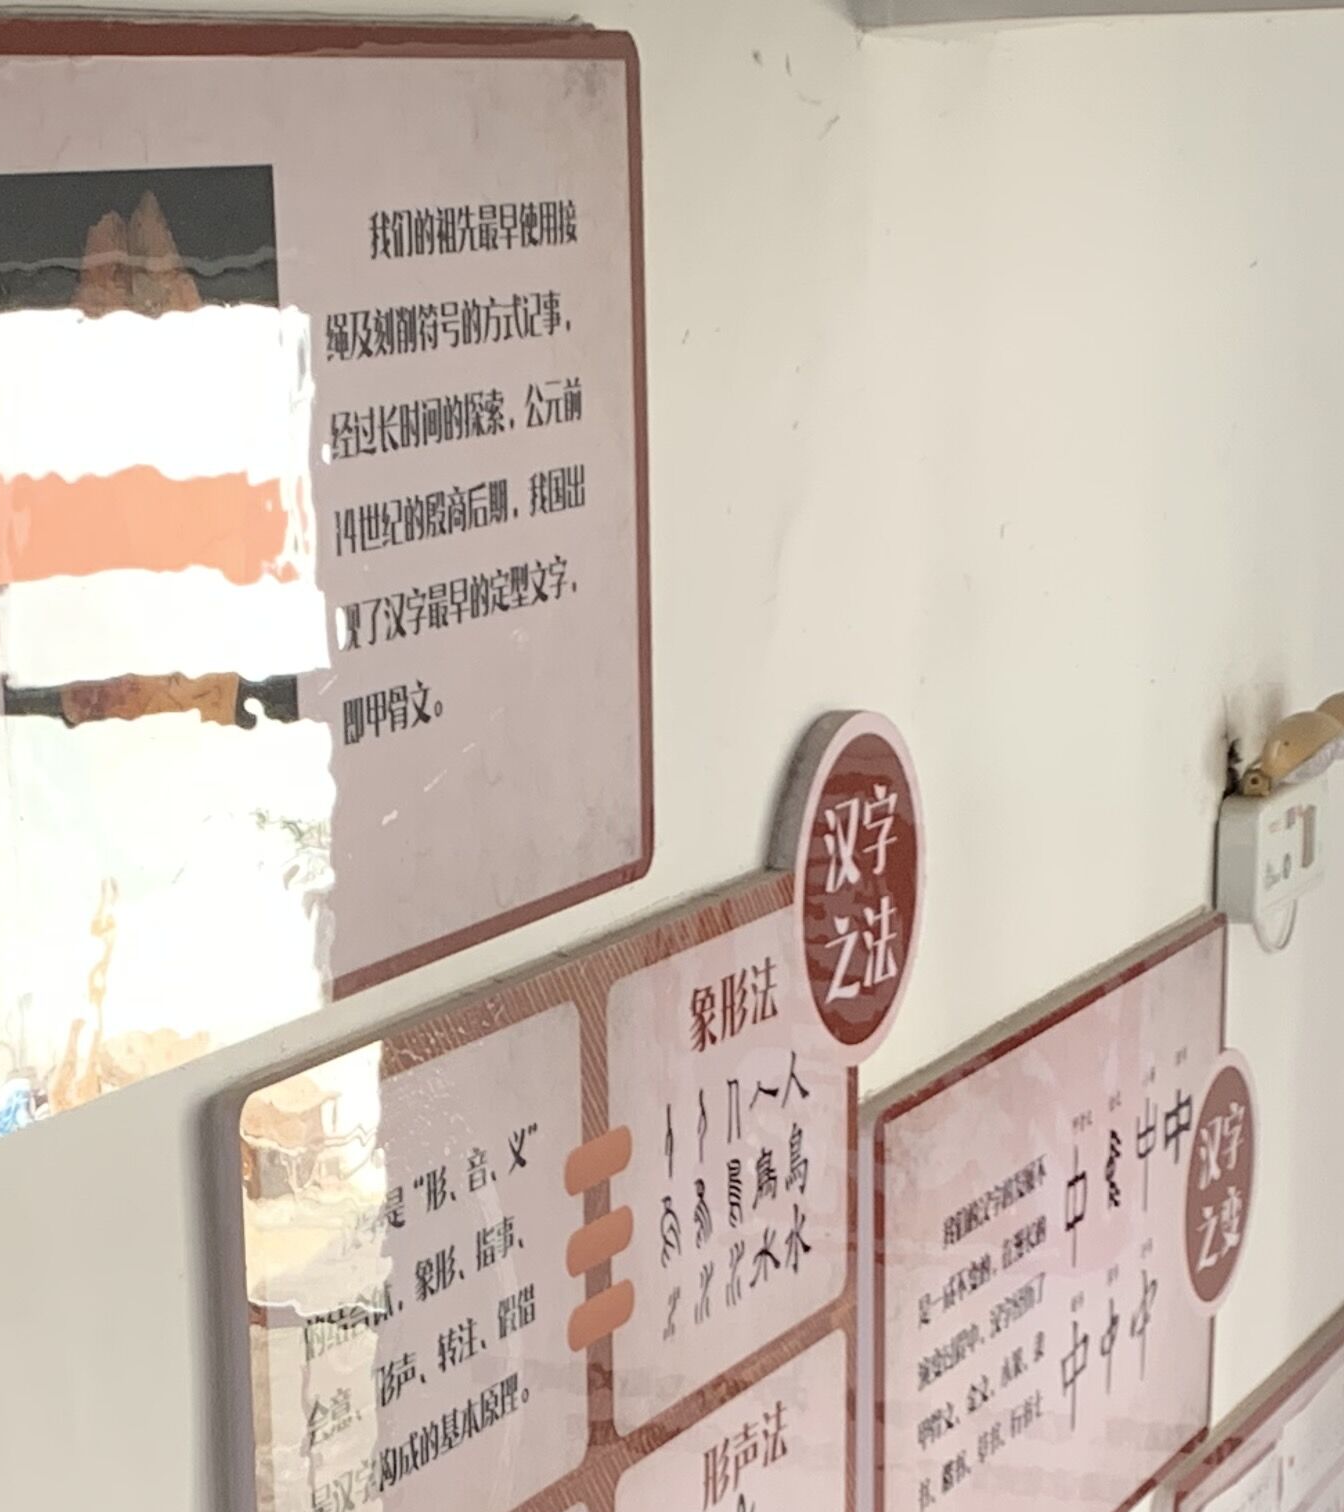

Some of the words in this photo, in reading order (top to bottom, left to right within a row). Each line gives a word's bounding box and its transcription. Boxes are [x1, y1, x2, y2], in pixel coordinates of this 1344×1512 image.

[368, 200, 578, 260] 我们的祖先最早使用接
[331, 377, 582, 460] 经过长时间的探索，公元前
[342, 679, 443, 746] 即甲骨文。
[824, 784, 897, 893] 汉字
[824, 896, 897, 1004] 之法
[689, 957, 778, 1052] 象形法
[1199, 1102, 1244, 1190] 汉字
[1196, 1186, 1242, 1272] 之变
[703, 1401, 787, 1511] 形声法
